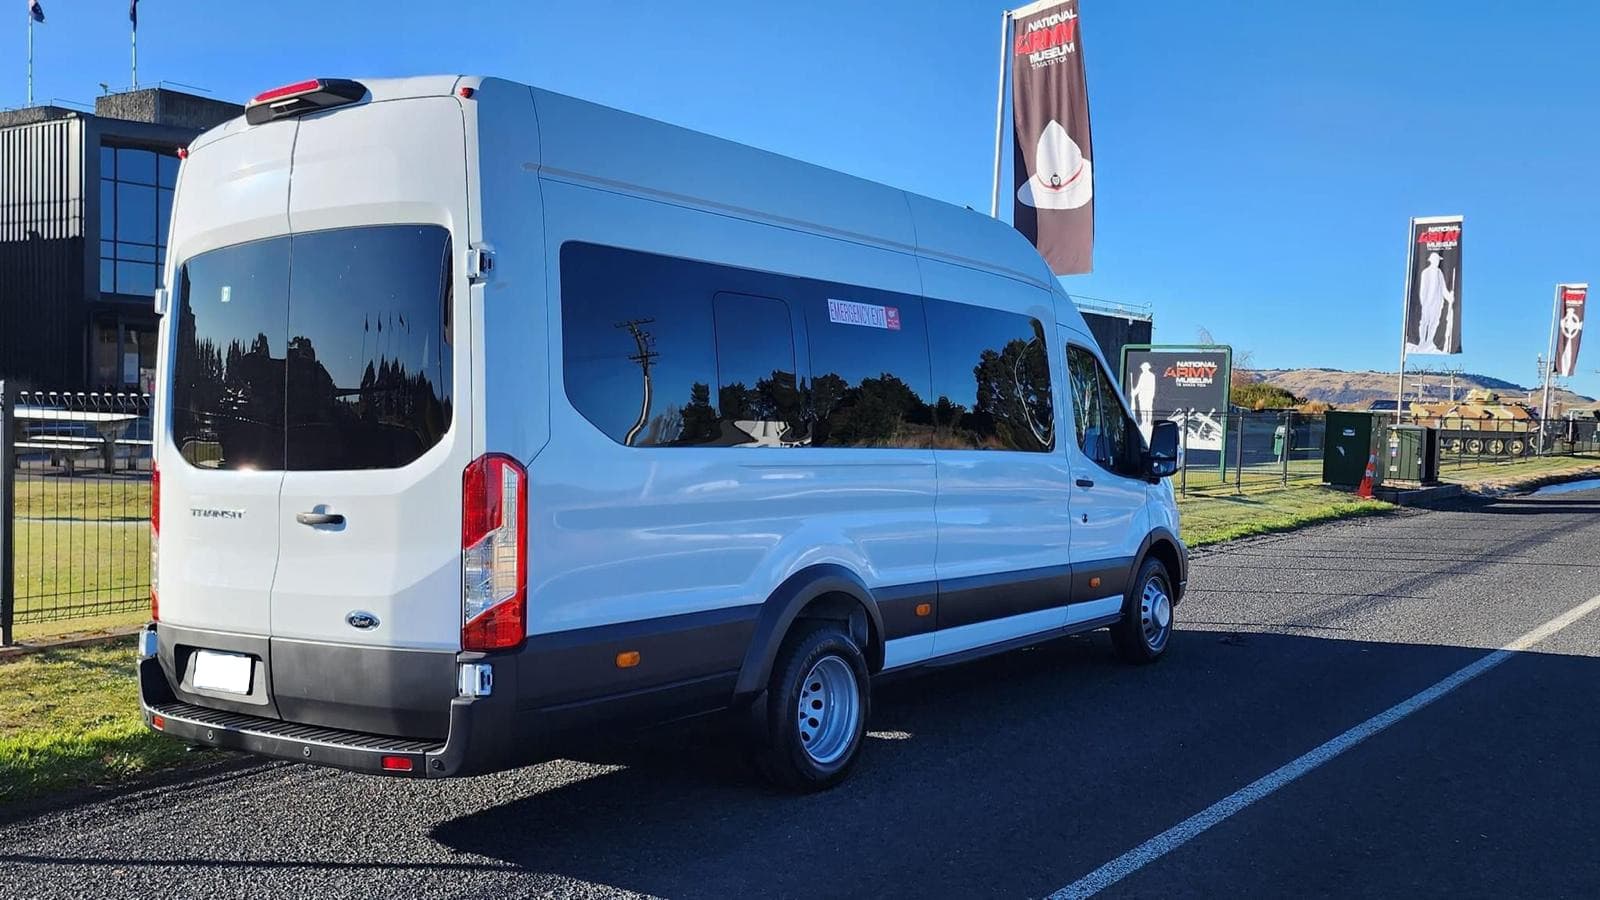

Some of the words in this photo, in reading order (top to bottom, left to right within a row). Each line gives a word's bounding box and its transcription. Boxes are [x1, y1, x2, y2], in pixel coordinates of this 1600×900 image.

[1028, 8, 1077, 32] NATIONAL
[1015, 18, 1078, 56] ARMY
[1029, 42, 1075, 64] MUSEUM
[830, 301, 871, 324] EMERGENCY
[871, 307, 885, 327] EXIT
[1163, 367, 1217, 378] ARMY
[1175, 377, 1213, 385] MUSEUM
[190, 508, 246, 519] TRANSIT
